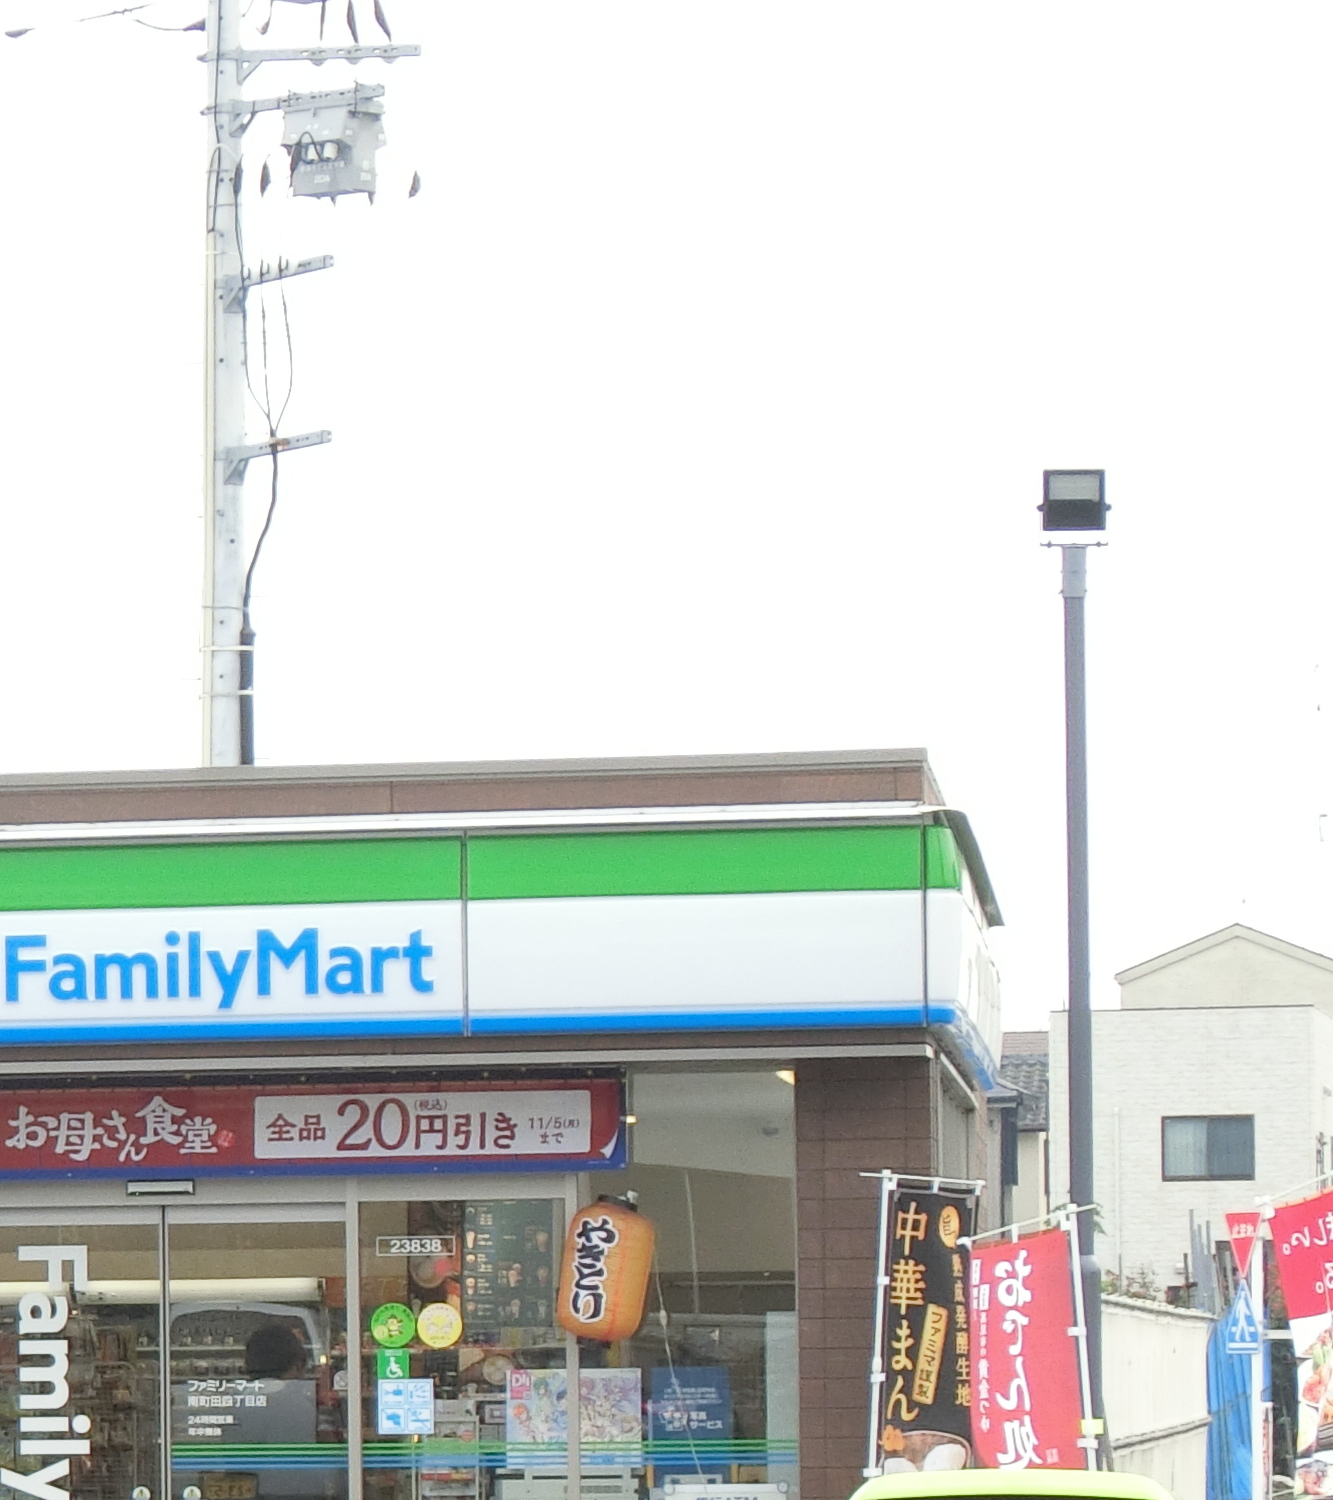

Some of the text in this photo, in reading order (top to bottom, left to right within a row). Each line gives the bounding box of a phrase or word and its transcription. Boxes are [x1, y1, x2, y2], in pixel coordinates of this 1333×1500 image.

[4, 927, 434, 1010] FamilyMart
[4, 1095, 219, 1163] お母さん食堂
[265, 1098, 518, 1152] 全品 20円引き
[539, 1131, 565, 1145] まで
[390, 1239, 443, 1253] 23838
[572, 1217, 617, 1321] やきとり
[888, 1201, 928, 1422] 中華まん
[187, 1380, 265, 1392] ファミリーマート
